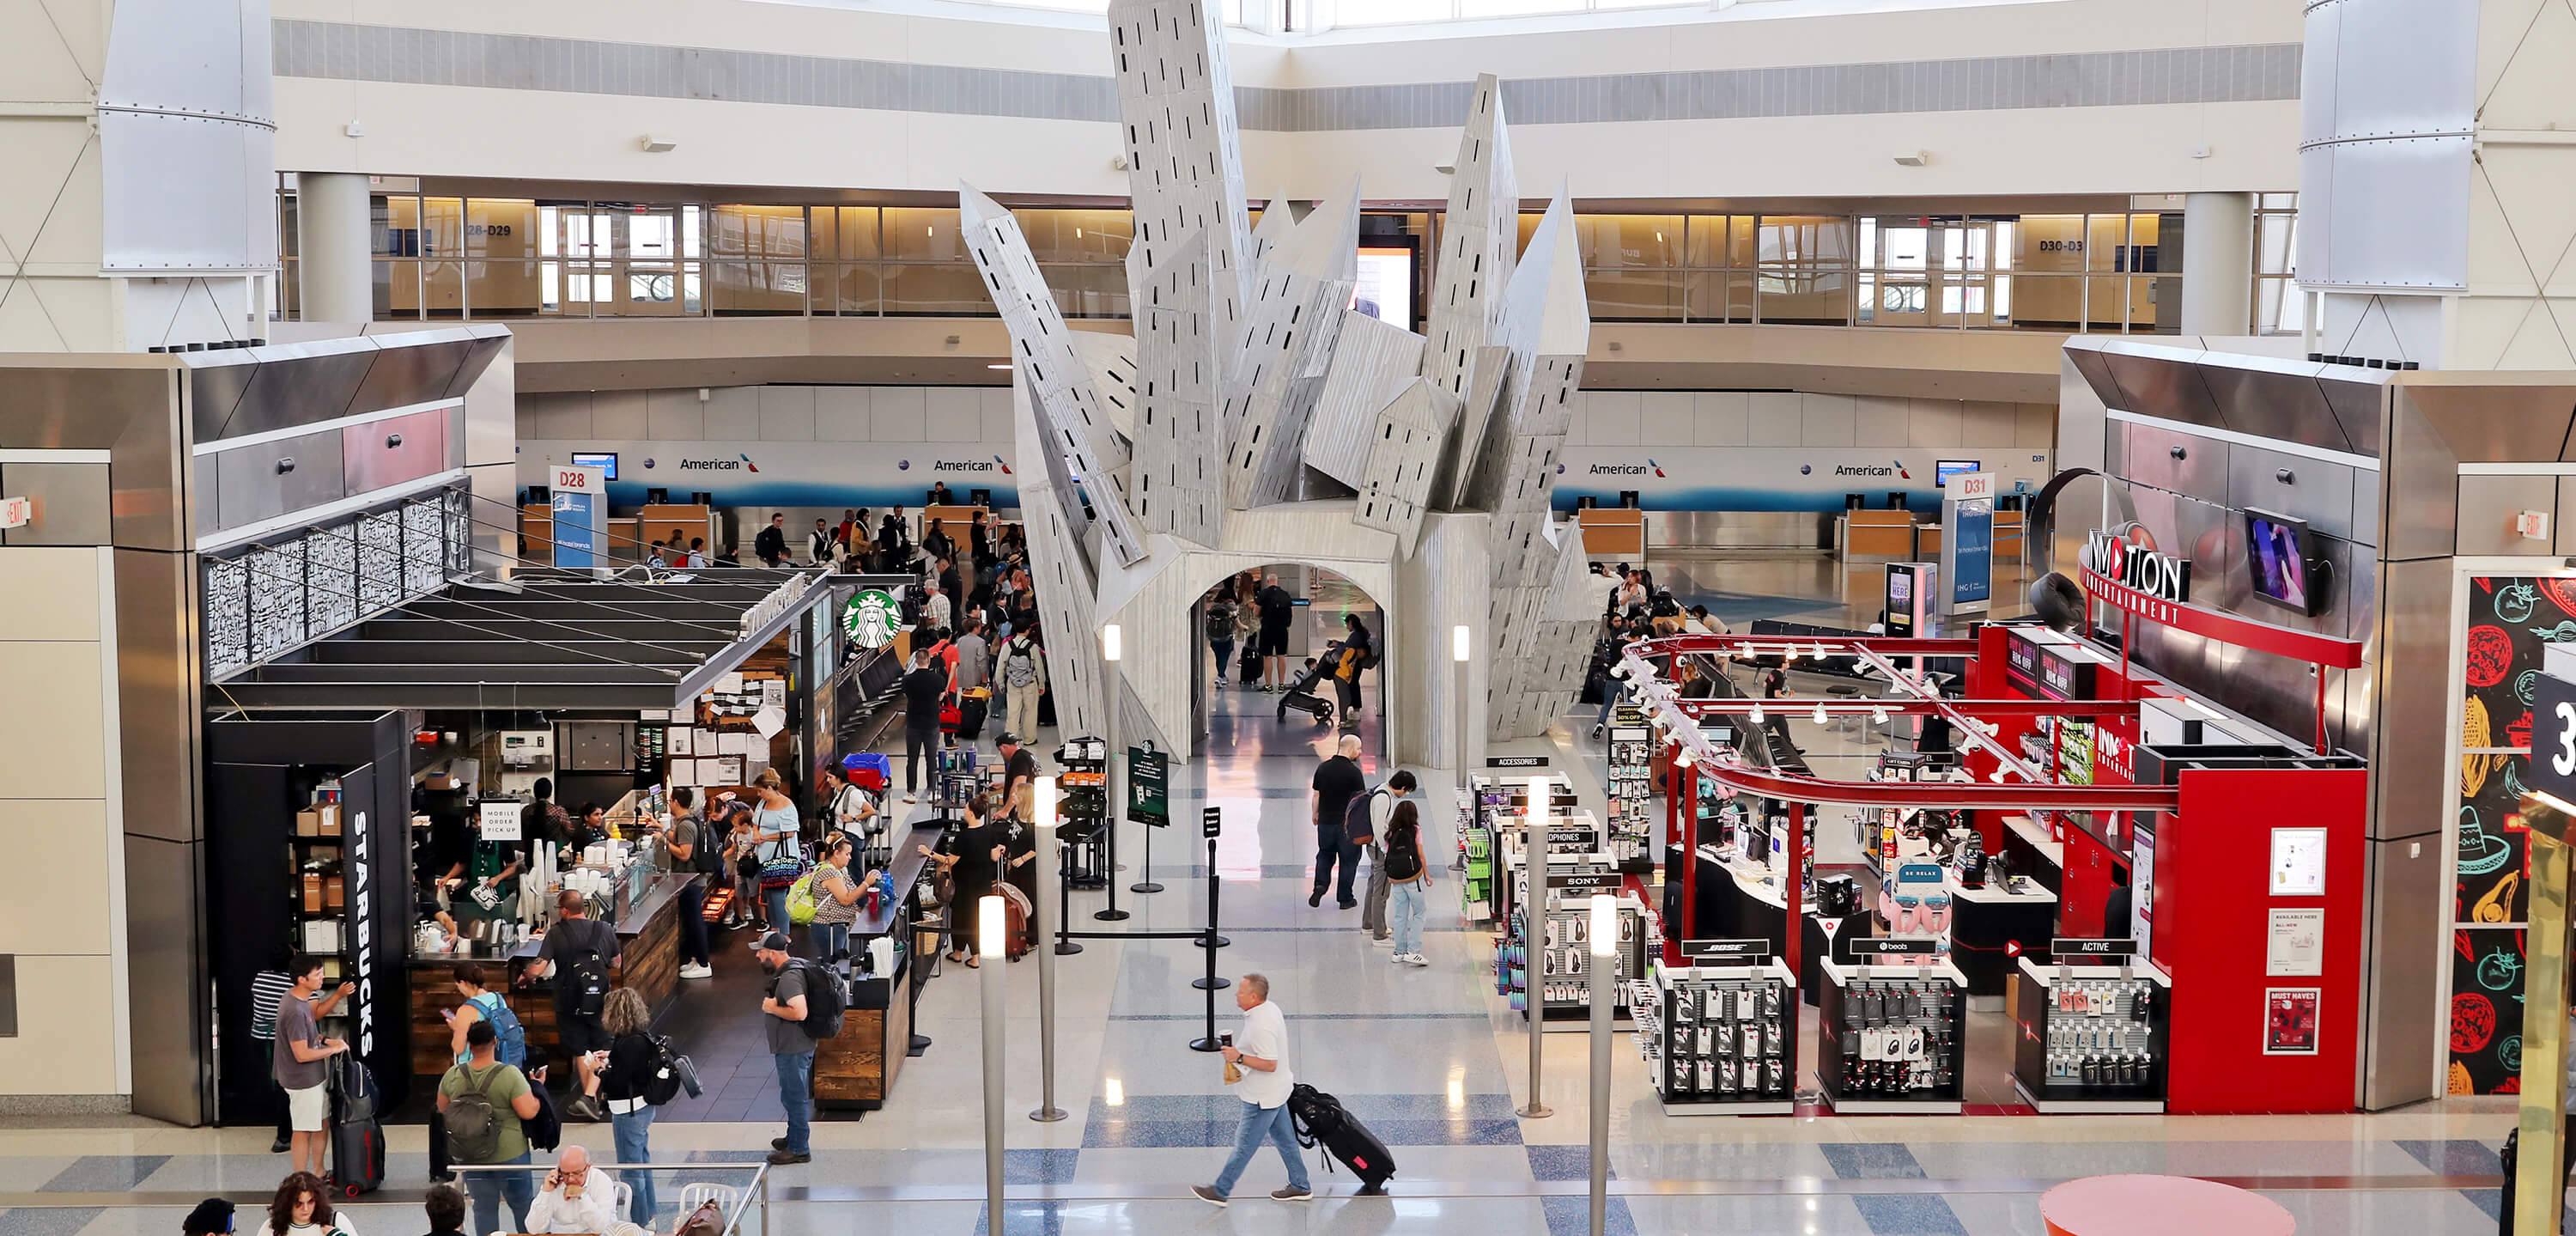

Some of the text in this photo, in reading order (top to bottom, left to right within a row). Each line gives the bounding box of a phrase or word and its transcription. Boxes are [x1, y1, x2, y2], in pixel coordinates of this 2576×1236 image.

[465, 225, 512, 235] 28-D29
[2040, 241, 2083, 251] D30-D3
[680, 458, 739, 470] American
[934, 460, 993, 471] American
[1589, 463, 1647, 474] American
[1835, 465, 1892, 476] American
[560, 471, 585, 488] D28
[1965, 478, 1986, 494] D31
[1893, 587, 1908, 598] HERE
[2085, 572, 2178, 625] ENTERTAINMENT
[2551, 701, 2576, 776] 3
[1498, 758, 1538, 766] ACCESSORIES
[1548, 833, 1580, 842] DPHONES
[355, 811, 373, 1057] STARBUCKS
[2081, 942, 2110, 952] ACTIVE
